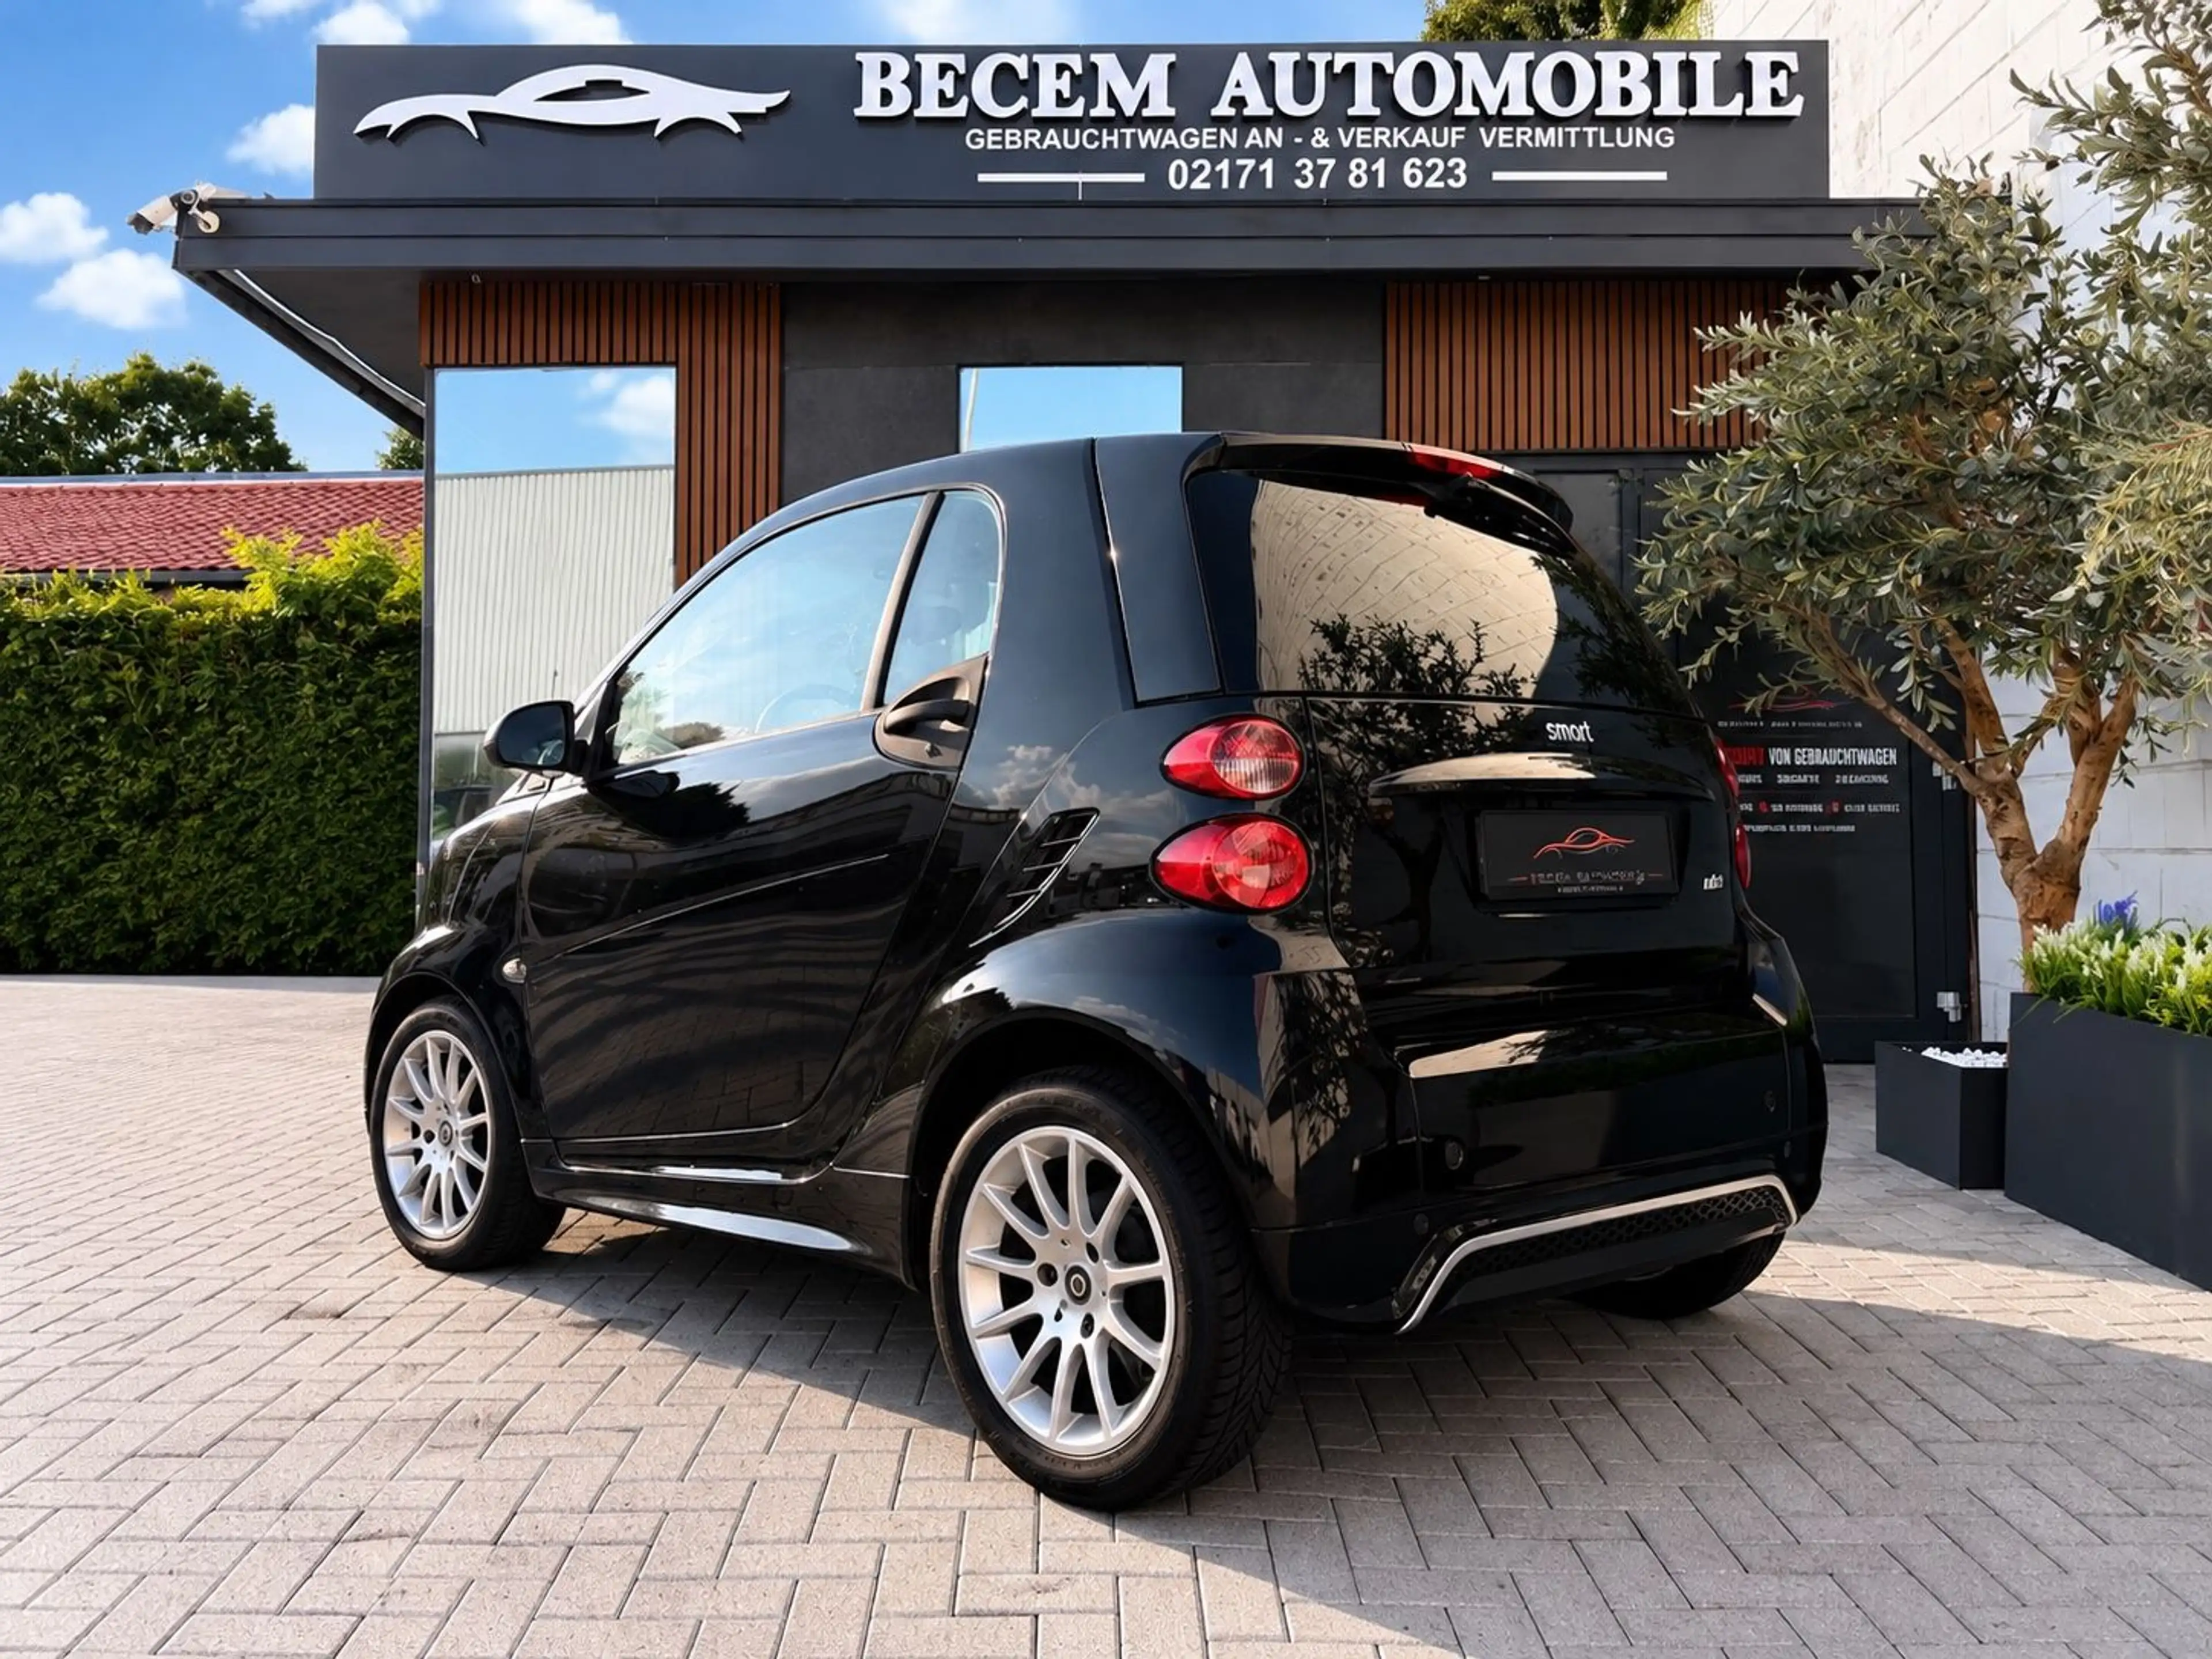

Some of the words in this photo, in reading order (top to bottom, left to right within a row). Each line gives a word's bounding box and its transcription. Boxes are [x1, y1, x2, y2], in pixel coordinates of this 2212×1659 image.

[853, 52, 1177, 119] BECEM
[1210, 51, 1805, 118] AUTOMOBILE
[965, 127, 1238, 150] GEBRAUCHTWAGEN
[1243, 127, 1283, 149] AN
[1310, 127, 1330, 149] &
[1337, 126, 1467, 149] VERKAUF
[1478, 126, 1676, 149] VERMITTLUNG
[1168, 157, 1274, 191] 02171
[1294, 157, 1337, 190] 37
[1347, 157, 1386, 189] 81
[1402, 157, 1468, 189] 623
[1794, 747, 1897, 766] GEBRAUCHTWAGEN
